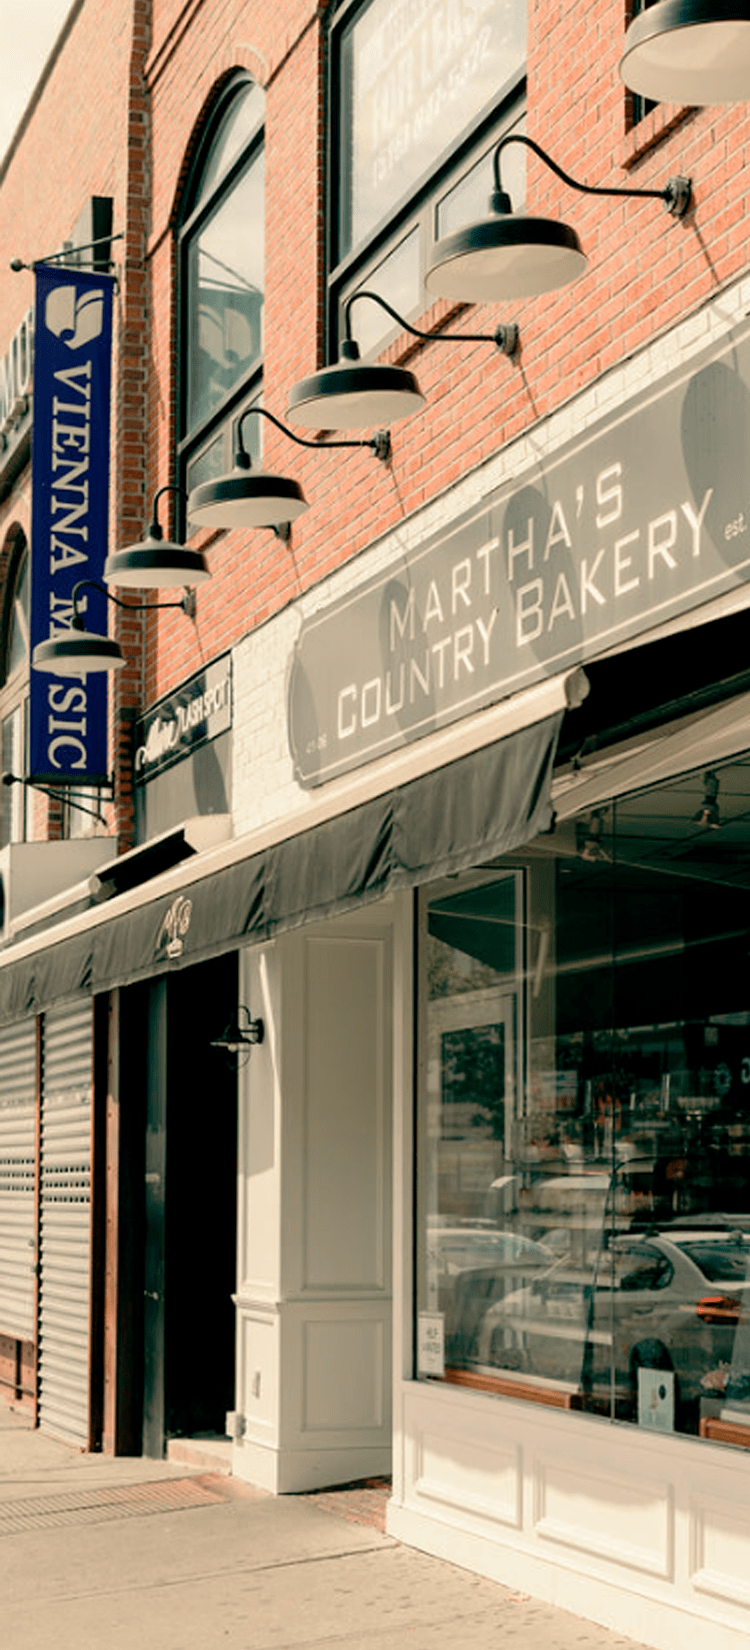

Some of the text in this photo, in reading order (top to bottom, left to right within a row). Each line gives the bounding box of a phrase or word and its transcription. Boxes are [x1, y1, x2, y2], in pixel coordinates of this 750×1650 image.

[420, 0, 494, 88] LEAS
[48, 360, 92, 770] VIENNA MSIC
[337, 605, 500, 740] COUNTRY
[516, 487, 714, 648] BAKERY
[390, 461, 622, 652] MARTHA'S
